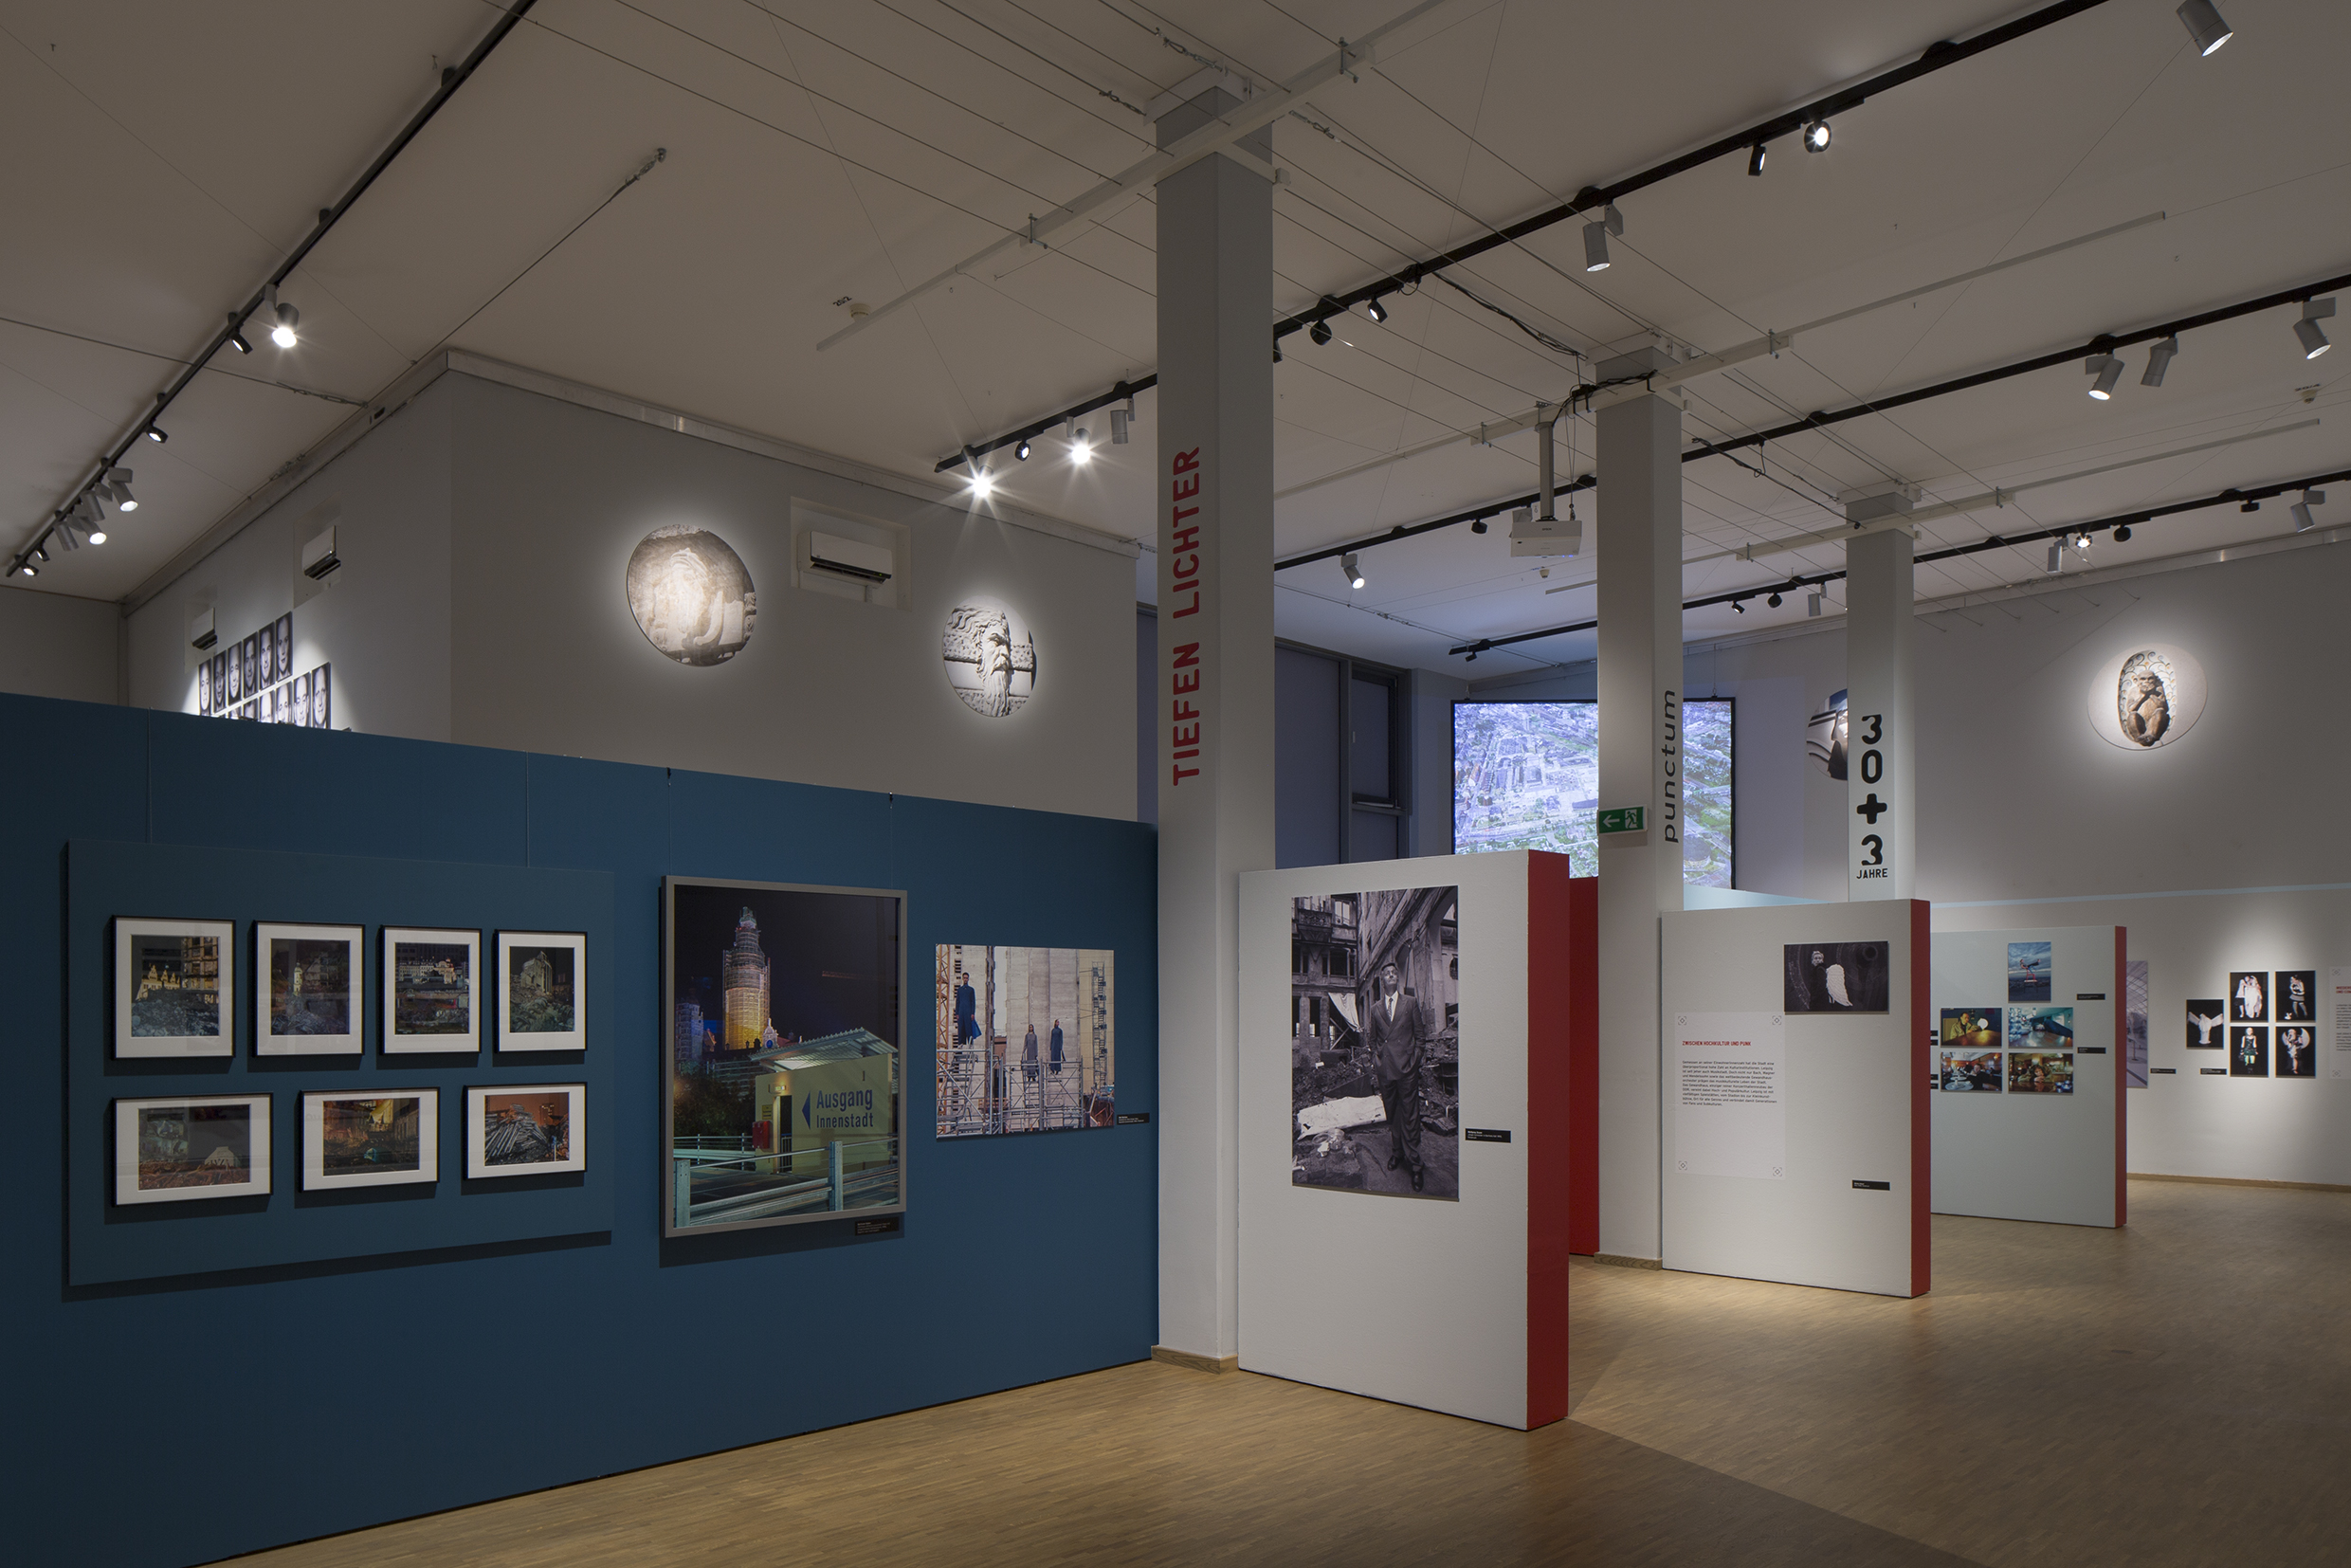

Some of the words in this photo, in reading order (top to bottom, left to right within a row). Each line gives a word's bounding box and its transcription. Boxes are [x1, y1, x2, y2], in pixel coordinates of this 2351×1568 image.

[1173, 446, 1200, 619] LICHTER
[1173, 641, 1200, 786] TIEFEN
[1661, 690, 1679, 843] punctum
[1856, 868, 1888, 879] JAHRE
[816, 1089, 873, 1111] Ausgang
[816, 1112, 874, 1128] Innenstadt
